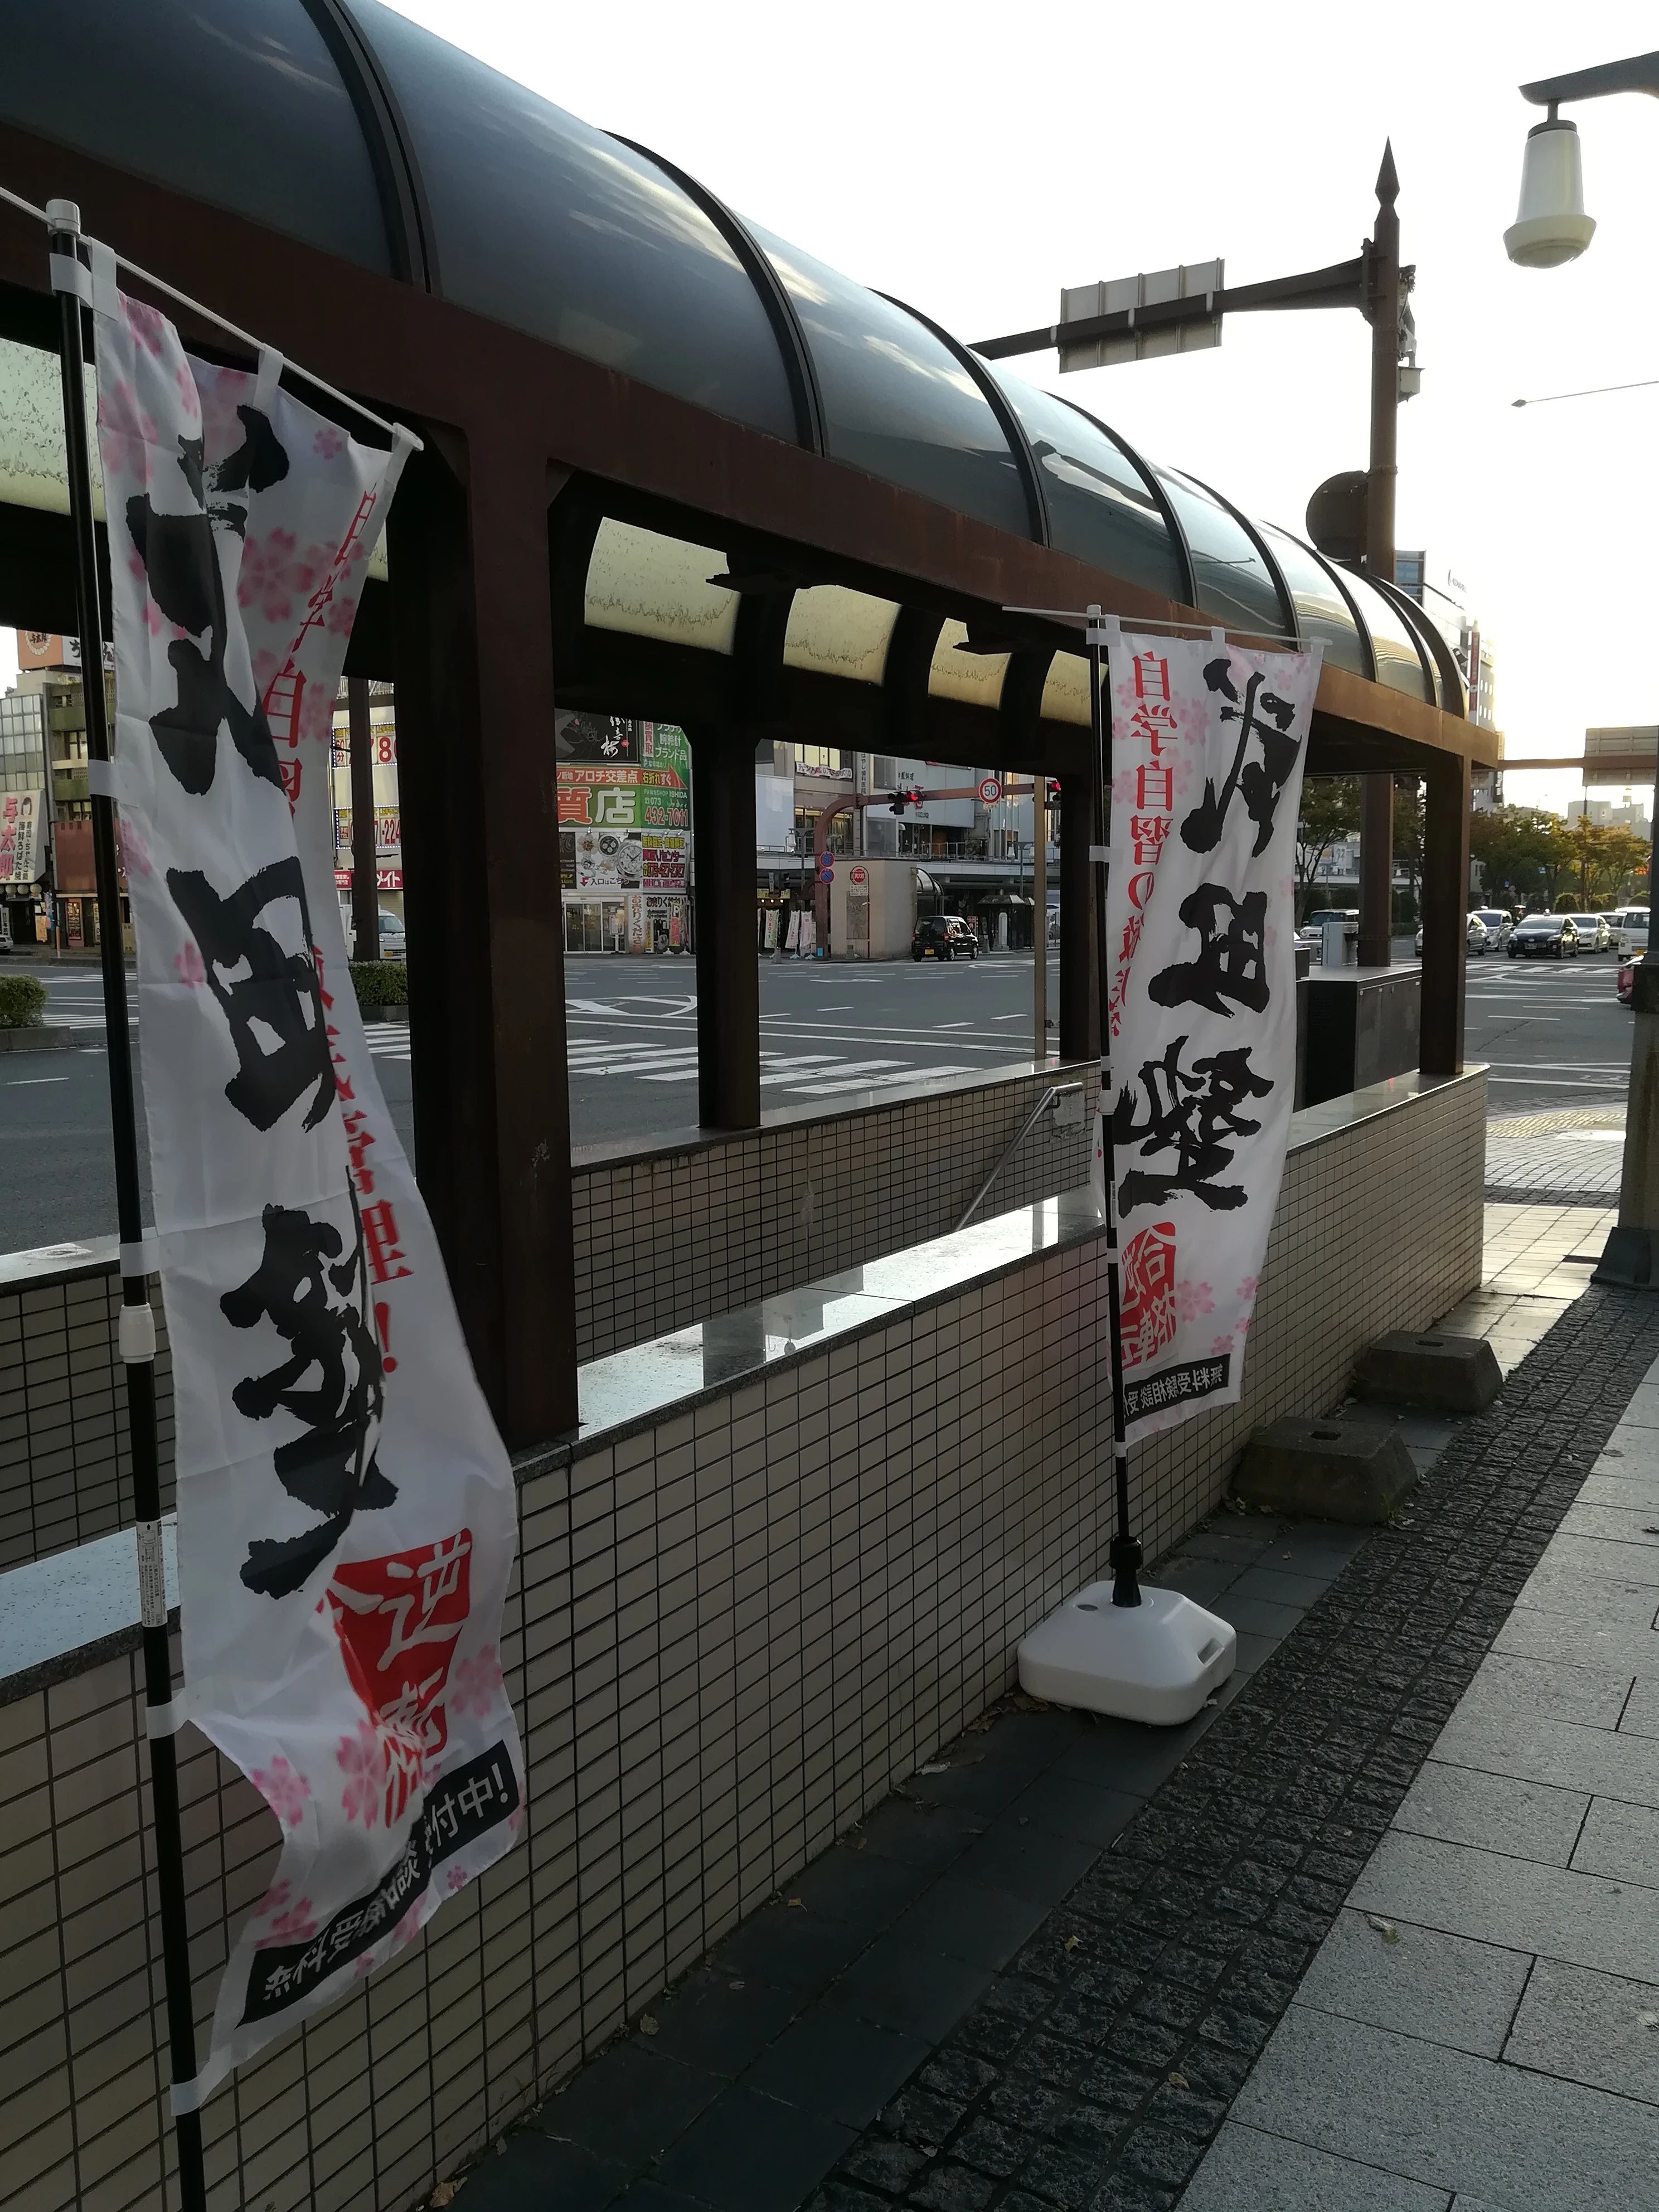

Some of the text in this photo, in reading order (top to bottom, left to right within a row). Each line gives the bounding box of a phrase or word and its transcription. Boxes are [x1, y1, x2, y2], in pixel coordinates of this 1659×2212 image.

[655, 747, 687, 760] ブランド品
[575, 770, 638, 783] アロチ交差点
[643, 772, 671, 785] 右折れすぐ
[669, 790, 687, 799] ISHIDA
[984, 785, 996, 796] 50
